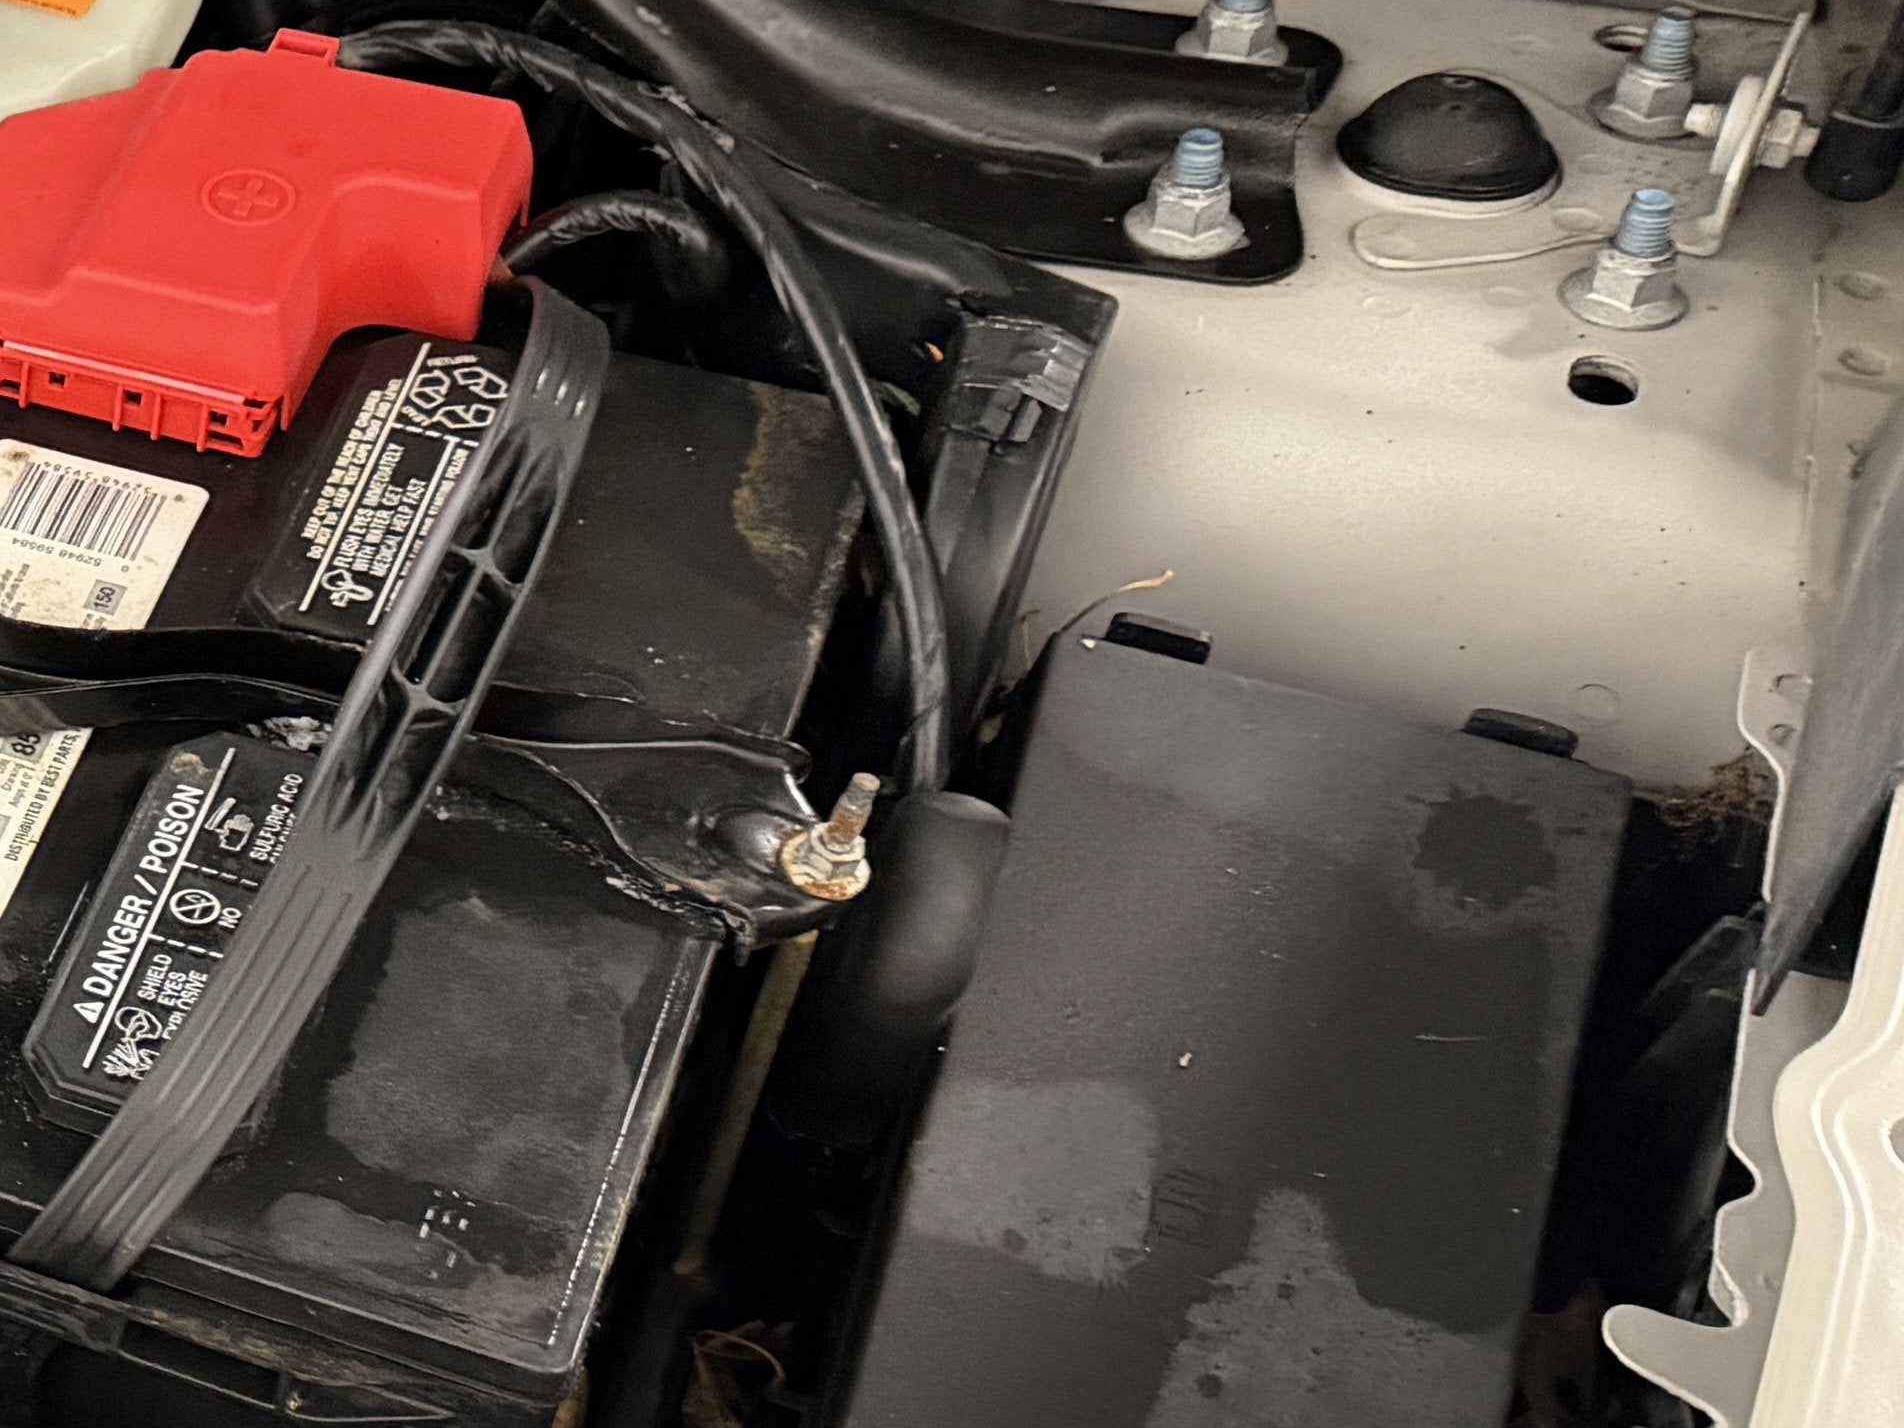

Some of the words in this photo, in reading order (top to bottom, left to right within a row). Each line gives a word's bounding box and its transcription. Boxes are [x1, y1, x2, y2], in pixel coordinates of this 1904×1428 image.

[333, 532, 361, 567] FLUSH
[348, 505, 374, 535] EYES
[361, 441, 404, 507] IMMEDIATELY
[352, 543, 377, 573] WITH
[381, 483, 404, 508] GET
[370, 531, 401, 577] MEDICAL
[390, 504, 412, 532] HELP
[402, 477, 426, 504] FAST
[92, 583, 116, 611] 150
[8, 724, 42, 758] 85
[34, 787, 49, 802] BY
[40, 763, 61, 788] BEST
[5, 799, 43, 861] DISTRIBUTED
[248, 801, 290, 861] SULFURIC
[276, 771, 303, 803] ACID
[81, 892, 152, 998] DANGER
[141, 781, 205, 875] POISON
[218, 906, 242, 929] NO
[138, 951, 173, 1000] SHIELD
[158, 969, 188, 1006] EYES
